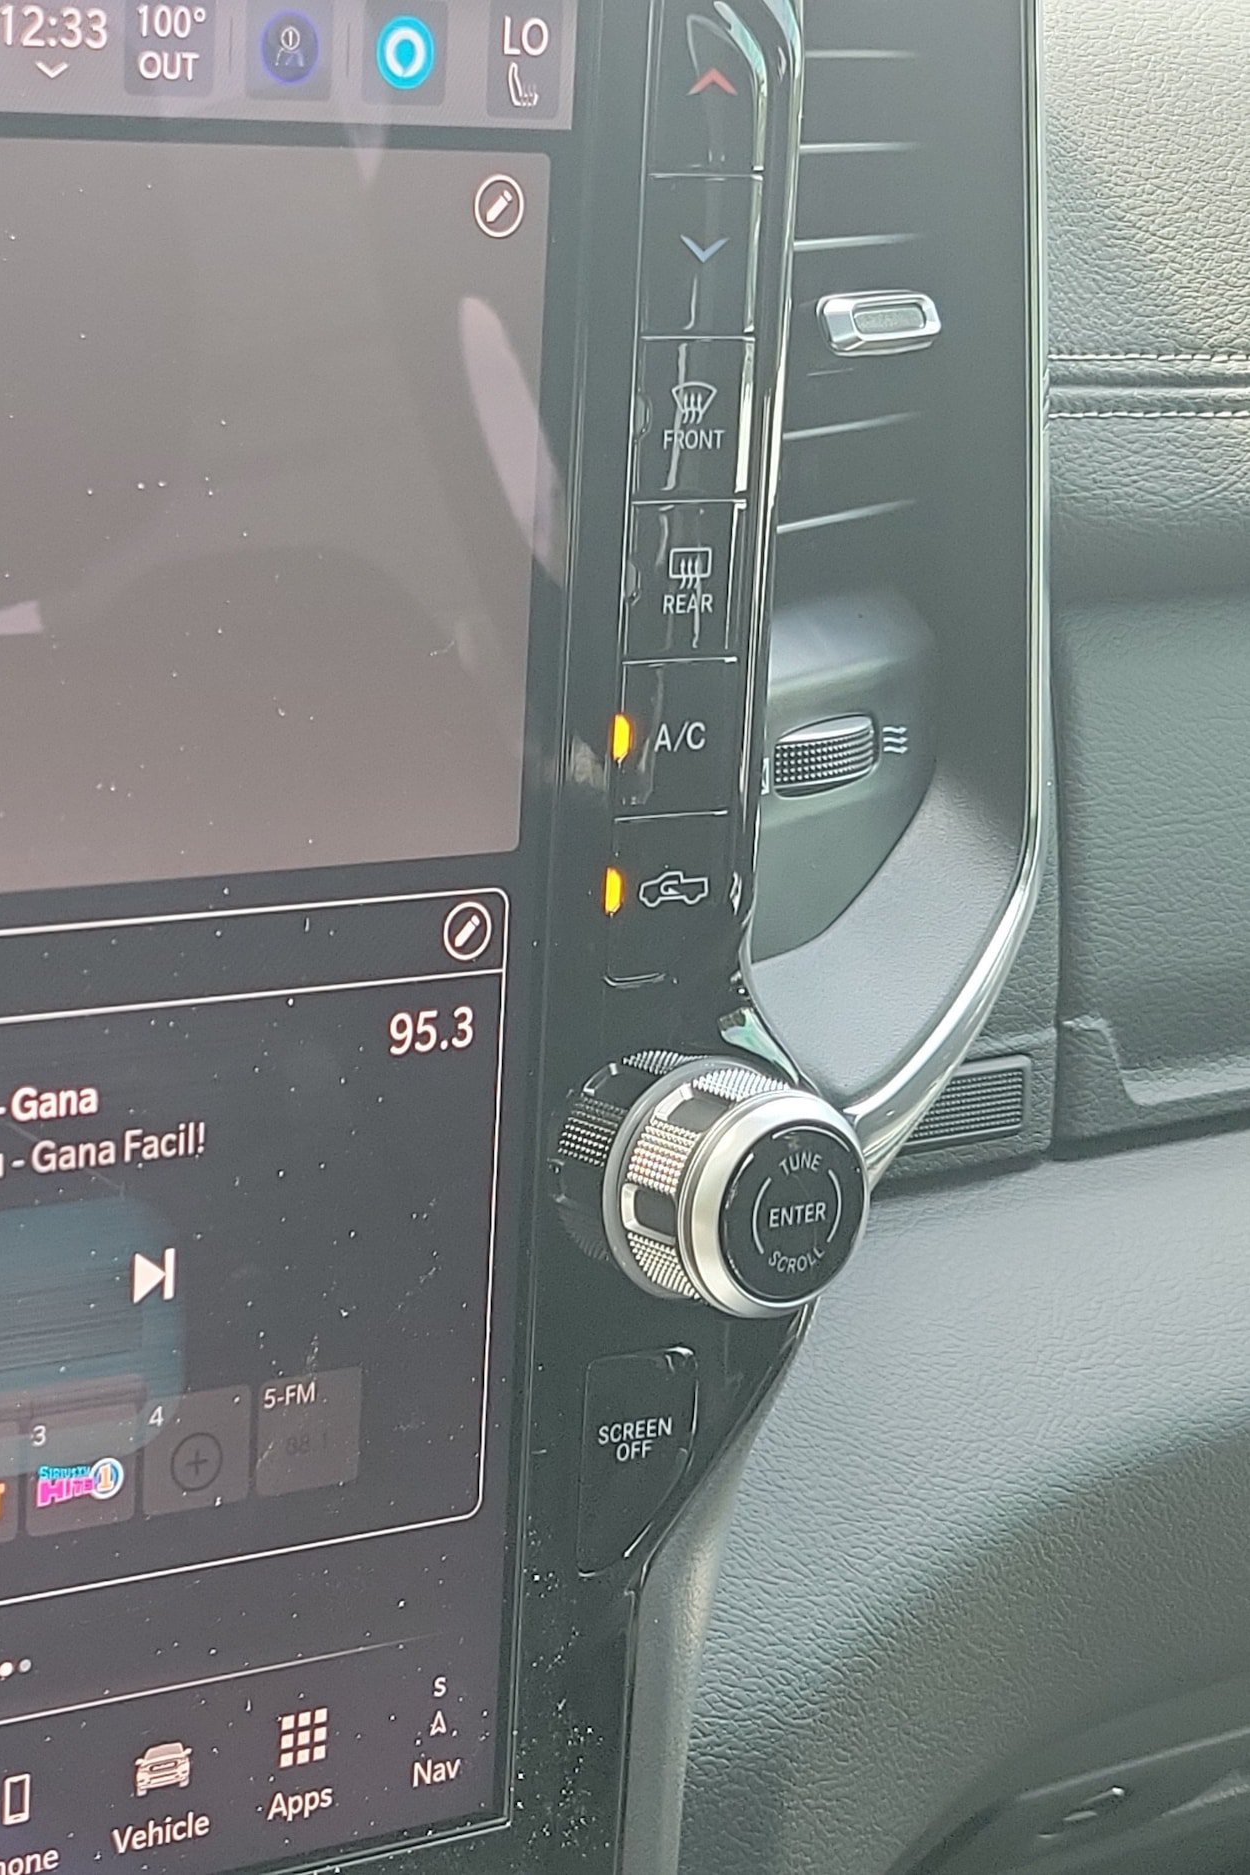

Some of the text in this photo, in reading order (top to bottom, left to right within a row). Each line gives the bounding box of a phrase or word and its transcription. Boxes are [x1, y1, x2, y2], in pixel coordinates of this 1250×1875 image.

[0, 4, 108, 49] 12:33
[503, 17, 549, 55] LO
[138, 51, 200, 81] OUT
[663, 429, 725, 450] FRONT
[662, 594, 714, 614] REAR
[654, 720, 706, 751] A/C
[388, 1007, 475, 1056] 95.3
[11, 1087, 98, 1122] Gana
[31, 1137, 115, 1175] Gana
[123, 1124, 206, 1162] Facil!
[779, 1154, 822, 1177] TUNE
[768, 1202, 827, 1229] ENTER
[768, 1247, 825, 1274] SCROLL
[263, 1381, 317, 1409] 5-FM
[149, 1406, 165, 1428] 4
[31, 1425, 47, 1447] 3
[598, 1418, 672, 1446] SCREEN
[616, 1442, 652, 1462] OFF
[434, 1678, 446, 1697] S
[412, 1757, 460, 1787] Nav
[267, 1786, 334, 1821] Apps
[112, 1811, 211, 1854] Vehicle
